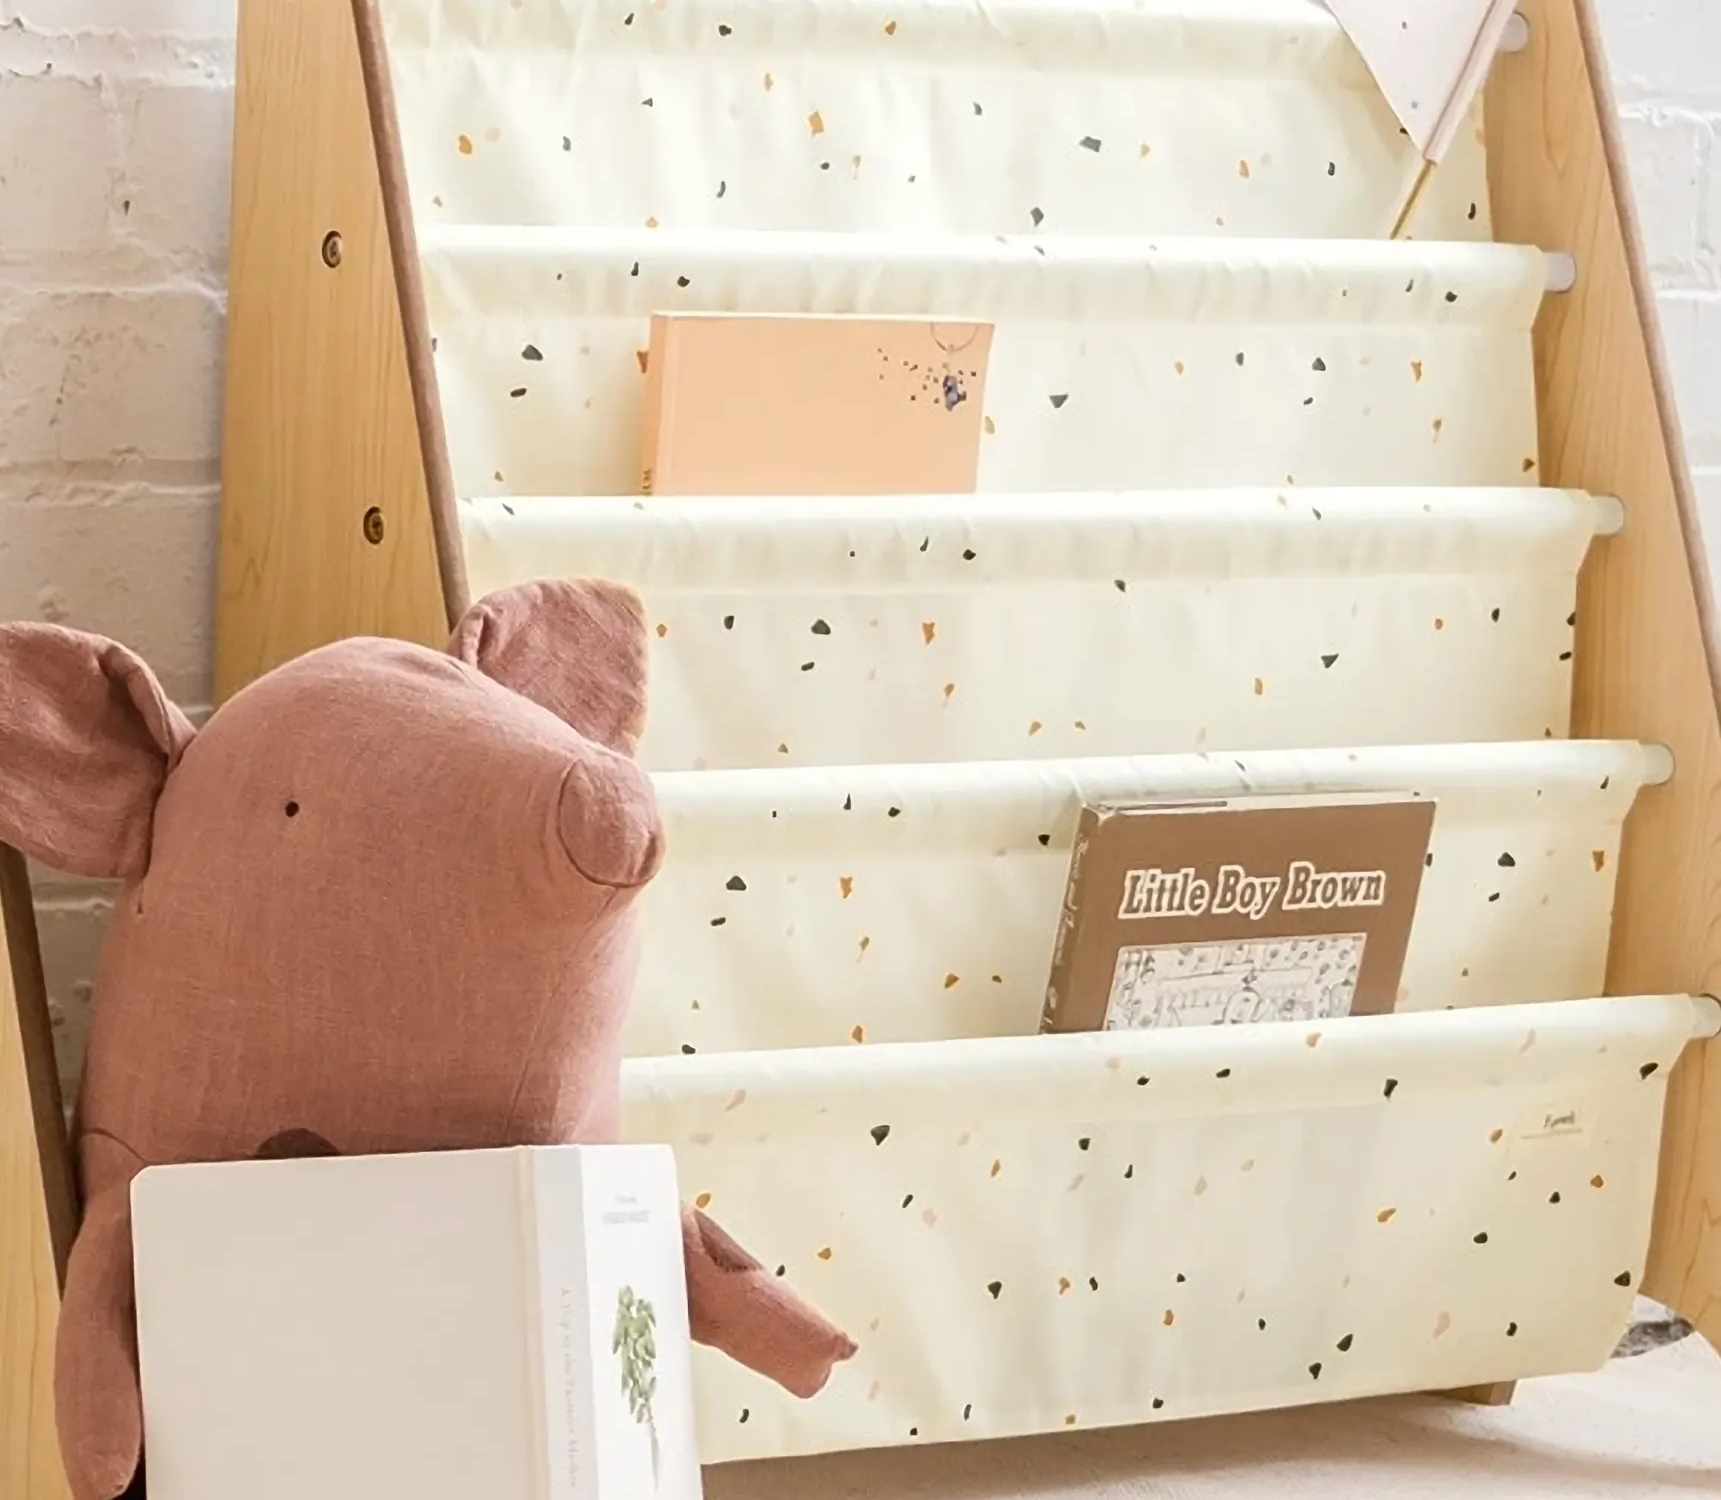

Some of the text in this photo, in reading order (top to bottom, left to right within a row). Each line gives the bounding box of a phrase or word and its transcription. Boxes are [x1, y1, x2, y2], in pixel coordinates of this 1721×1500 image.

[1118, 861, 1386, 920] Little Boy Brown
